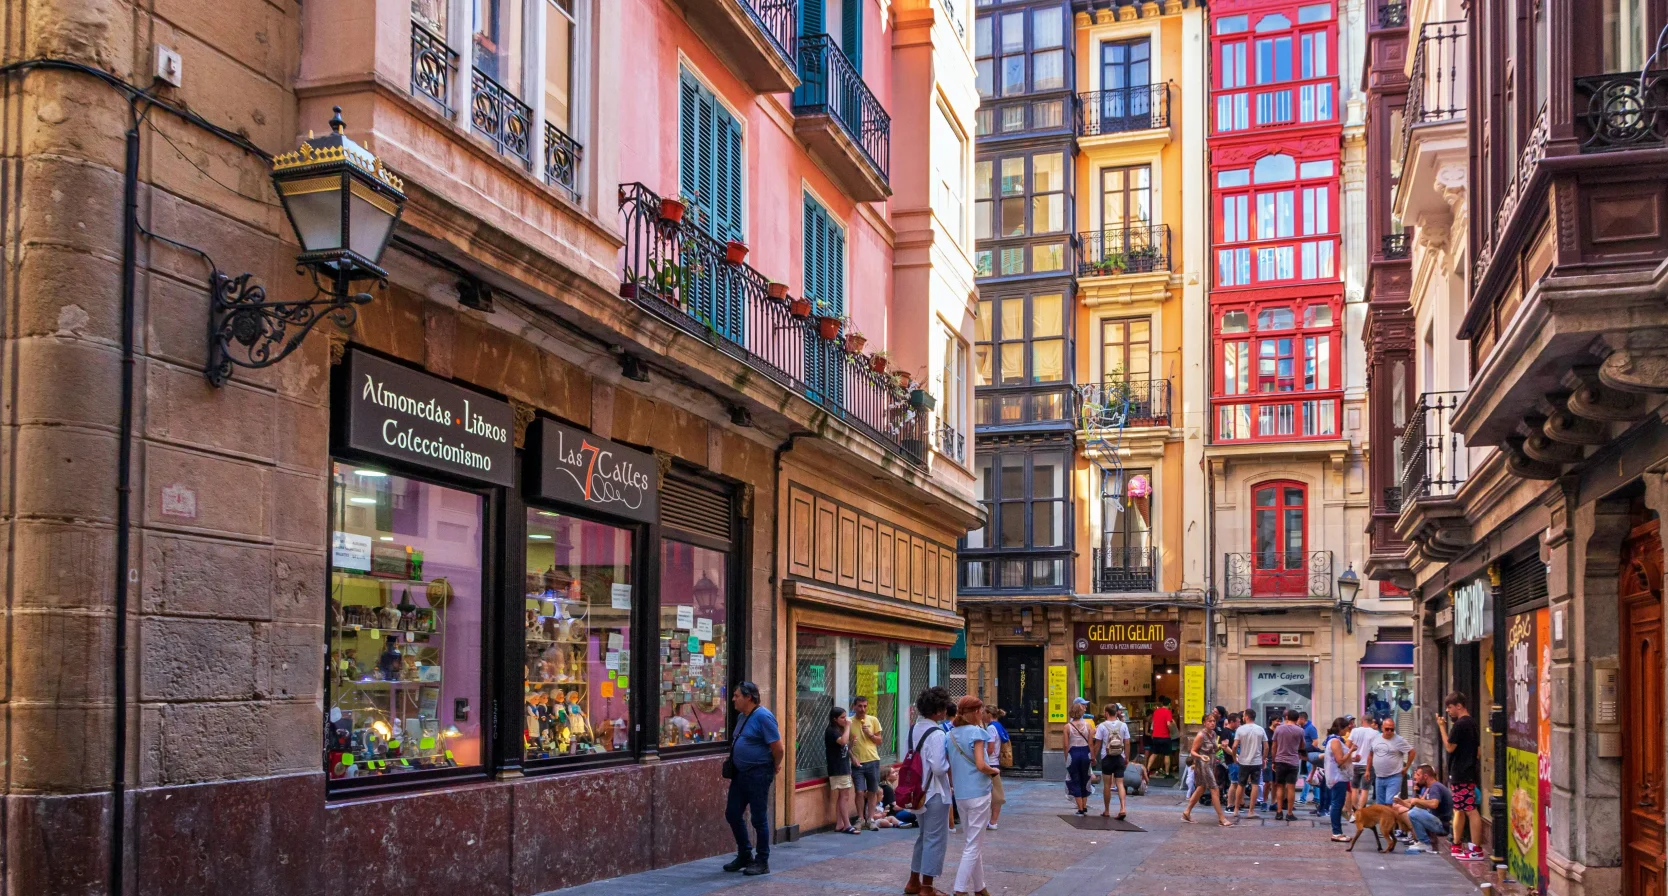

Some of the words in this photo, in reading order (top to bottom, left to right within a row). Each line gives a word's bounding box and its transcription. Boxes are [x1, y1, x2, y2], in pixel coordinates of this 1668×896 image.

[363, 374, 451, 426] Almonedas
[464, 399, 507, 443] Libros
[383, 419, 491, 471] Coleccionismo
[558, 431, 583, 467] Las
[581, 439, 600, 501] 7
[598, 451, 648, 490] Calles
[1088, 624, 1125, 641] GELATI
[1127, 624, 1165, 641] GELATI
[1257, 672, 1277, 680] ATM
[1280, 672, 1305, 681] Cajero
